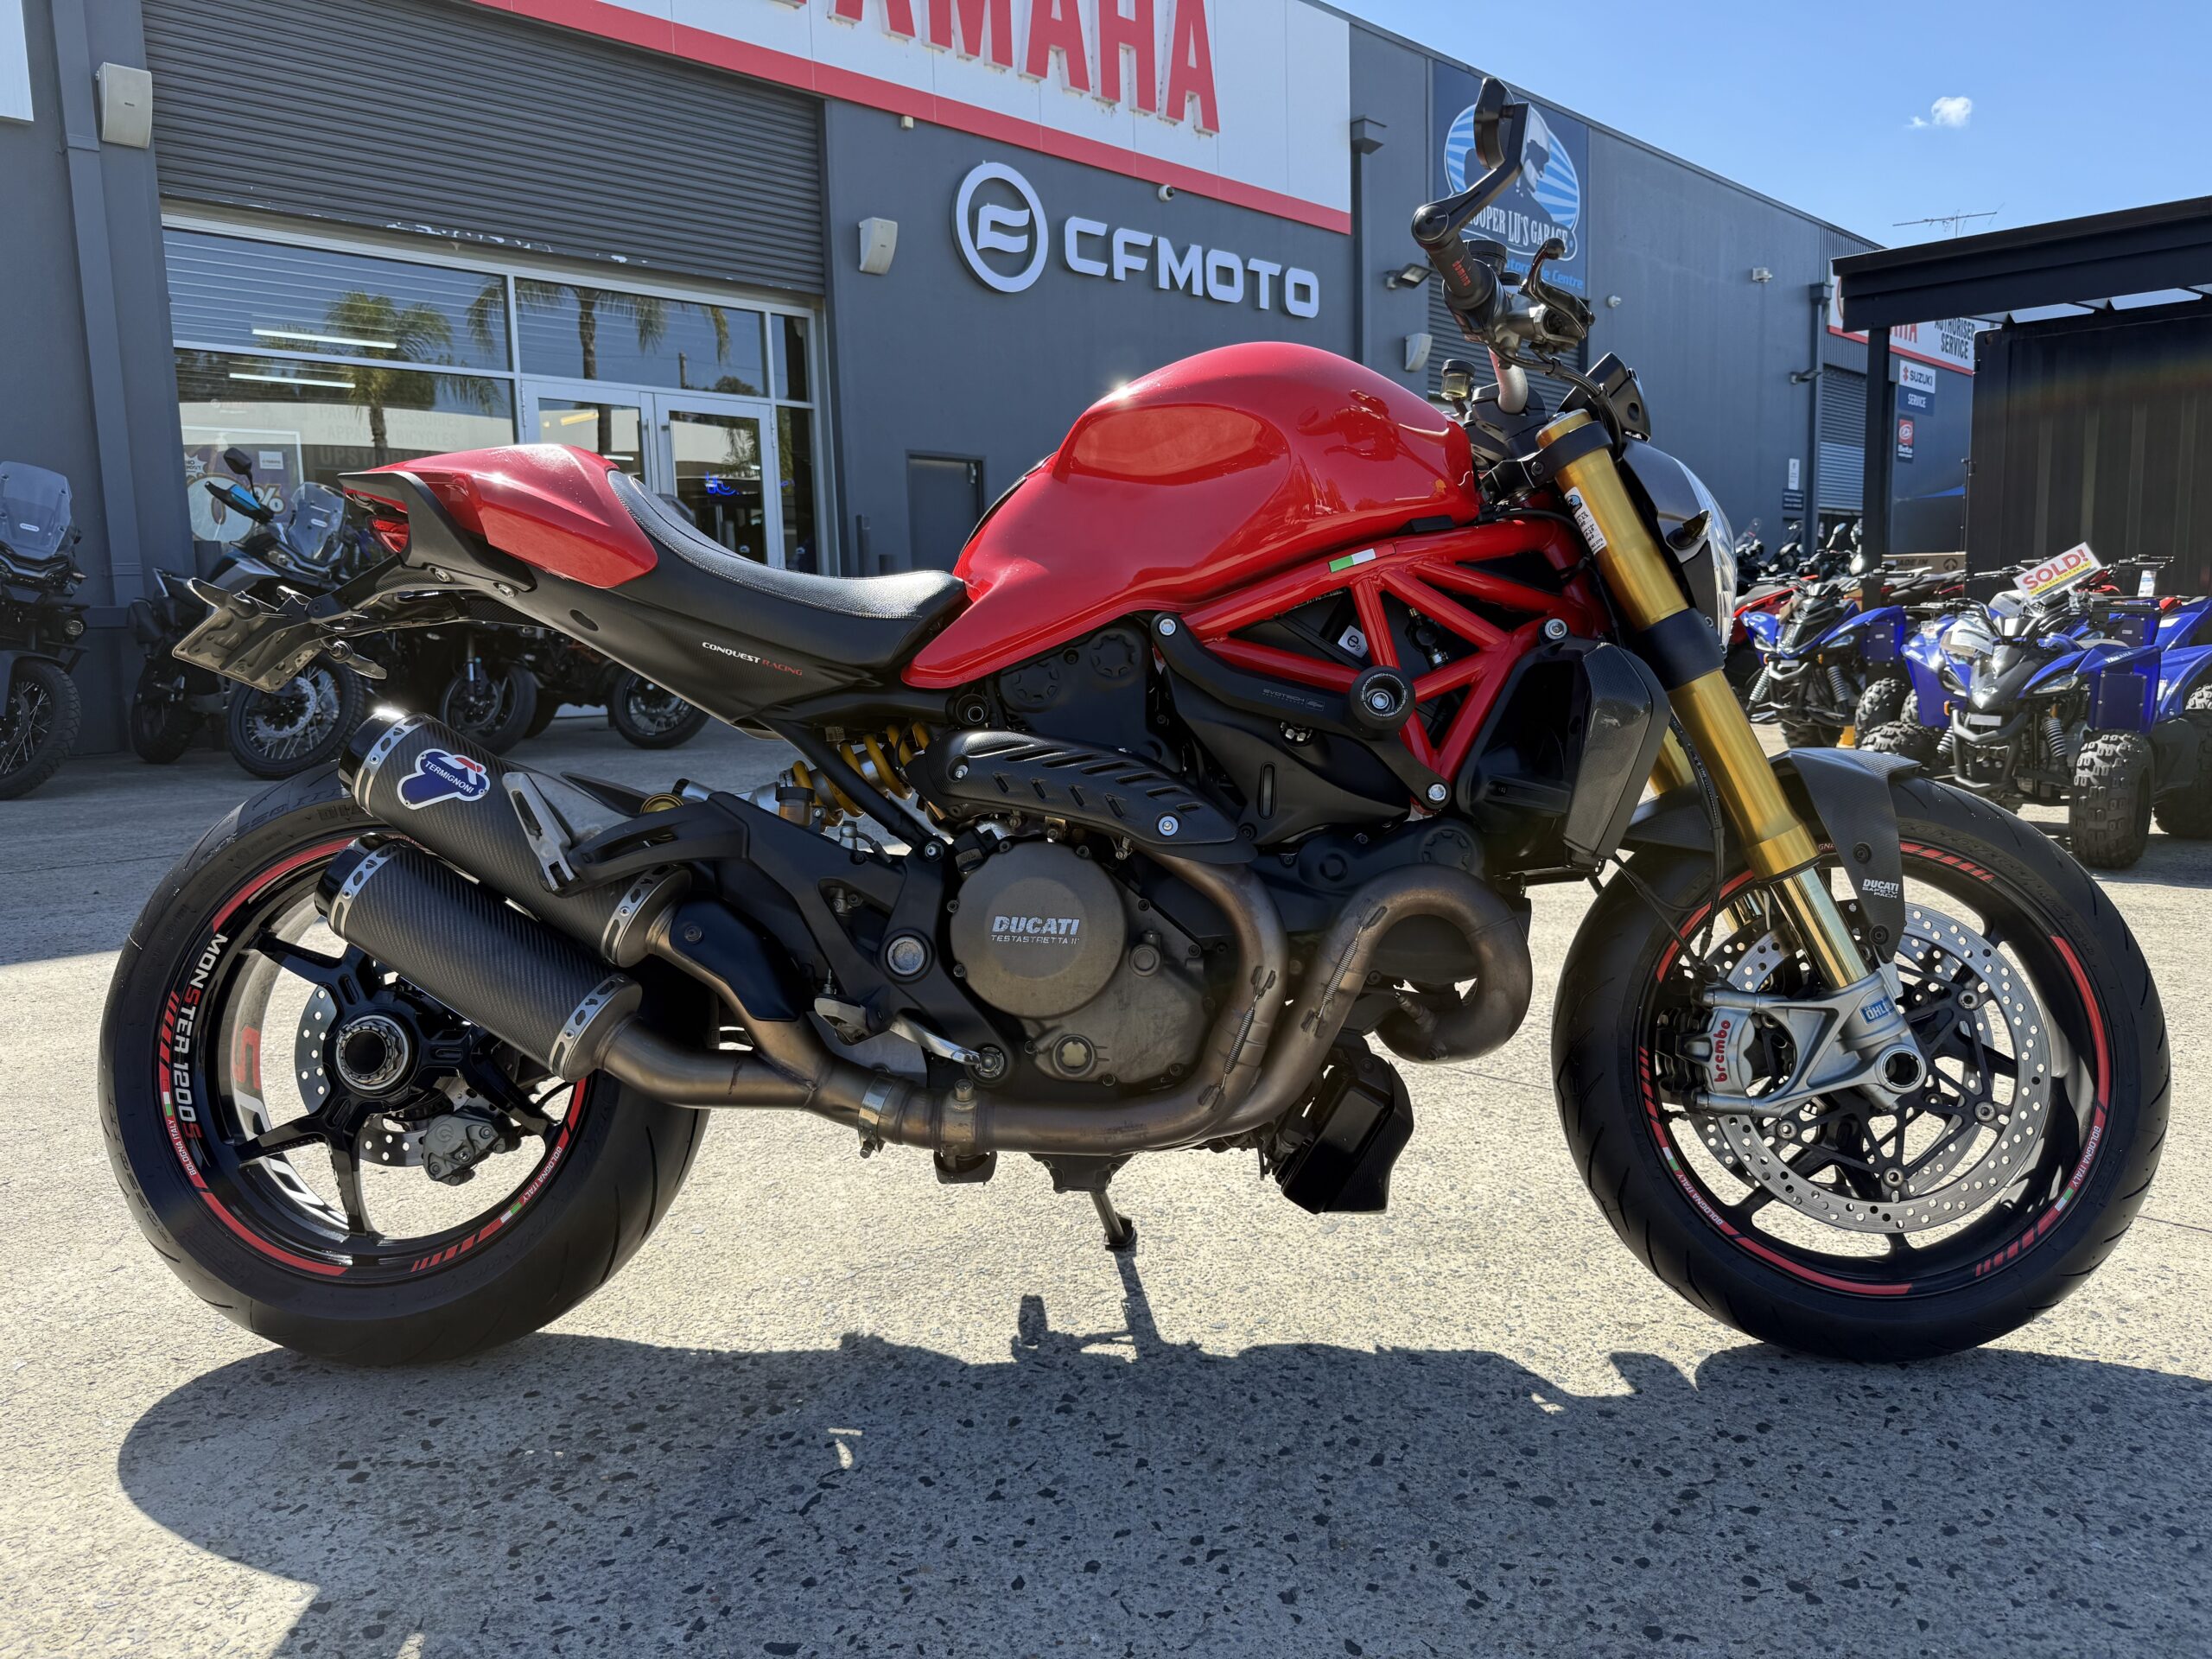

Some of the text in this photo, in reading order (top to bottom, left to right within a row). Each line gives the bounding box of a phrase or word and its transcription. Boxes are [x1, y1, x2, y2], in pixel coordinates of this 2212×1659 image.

[1469, 205, 1505, 234] OOPER
[1508, 210, 1529, 246] LU'S
[1064, 216, 1319, 318] CFMOTO
[1553, 270, 1583, 289] Centre
[1935, 318, 1975, 341] AUTHORISED
[1941, 333, 1968, 359] SERVICE
[1910, 370, 1933, 386] SUZUKI
[1907, 393, 1926, 408] SERVICE
[380, 410, 462, 429] CCESSORIES
[2023, 549, 2089, 590] SOLD!
[702, 641, 803, 676] CONQUEST RACING
[2104, 651, 2134, 664] YAMAHA
[424, 760, 474, 794] TERMIGNONI
[1862, 887, 1898, 895] SAFETY
[1863, 878, 1899, 892] DUCATI
[991, 916, 1080, 935] DUCATI
[991, 934, 1068, 944] TESTASTRETTA
[174, 933, 229, 1054] MONSTER
[1713, 1020, 1731, 1083] brembo
[168, 1118, 197, 1177] BOLOGNA ITALY
[2072, 1125, 2101, 1187] BOLOGNA ITALY
[522, 1146, 563, 1203] BOLOGNA ITALY
[1676, 1174, 1724, 1225] BOLOGNA ITALY
